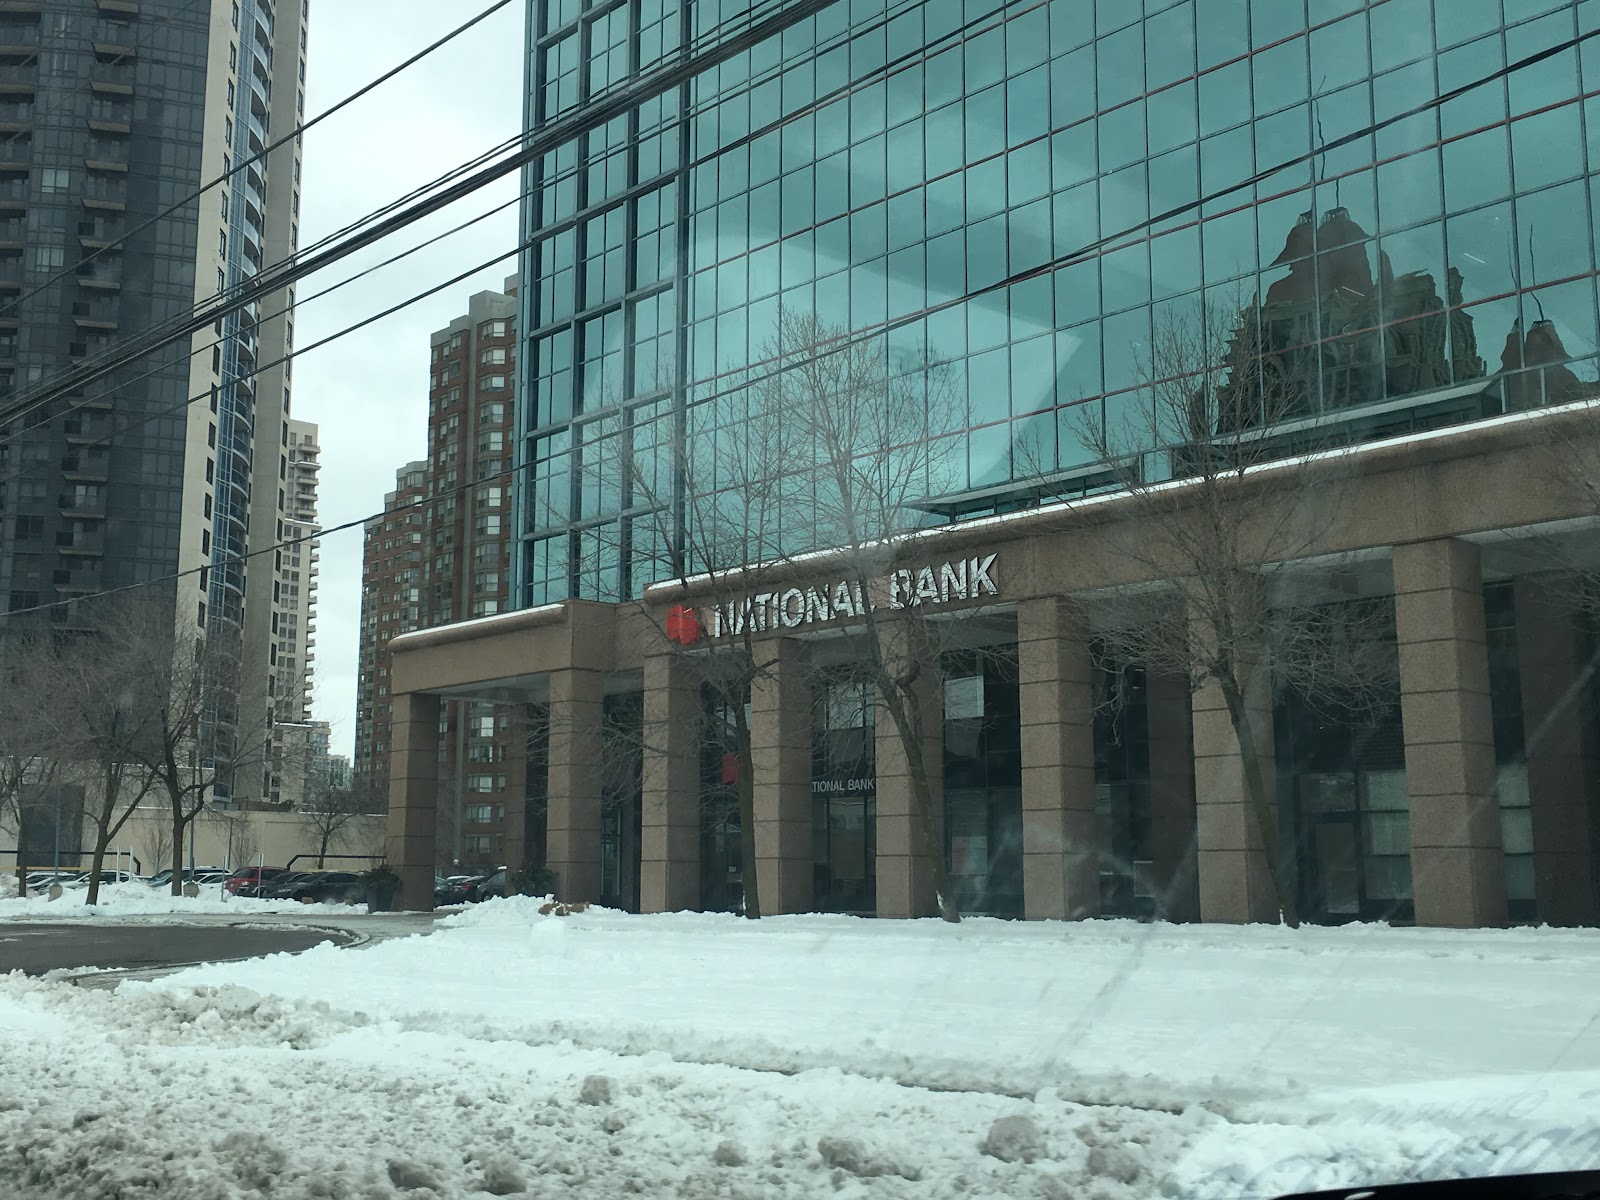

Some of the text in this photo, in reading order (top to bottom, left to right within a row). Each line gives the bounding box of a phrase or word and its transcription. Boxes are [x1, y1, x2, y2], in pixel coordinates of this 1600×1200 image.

[714, 553, 998, 638] NATIONAL BANK
[811, 778, 875, 793] TIONAL BANK
